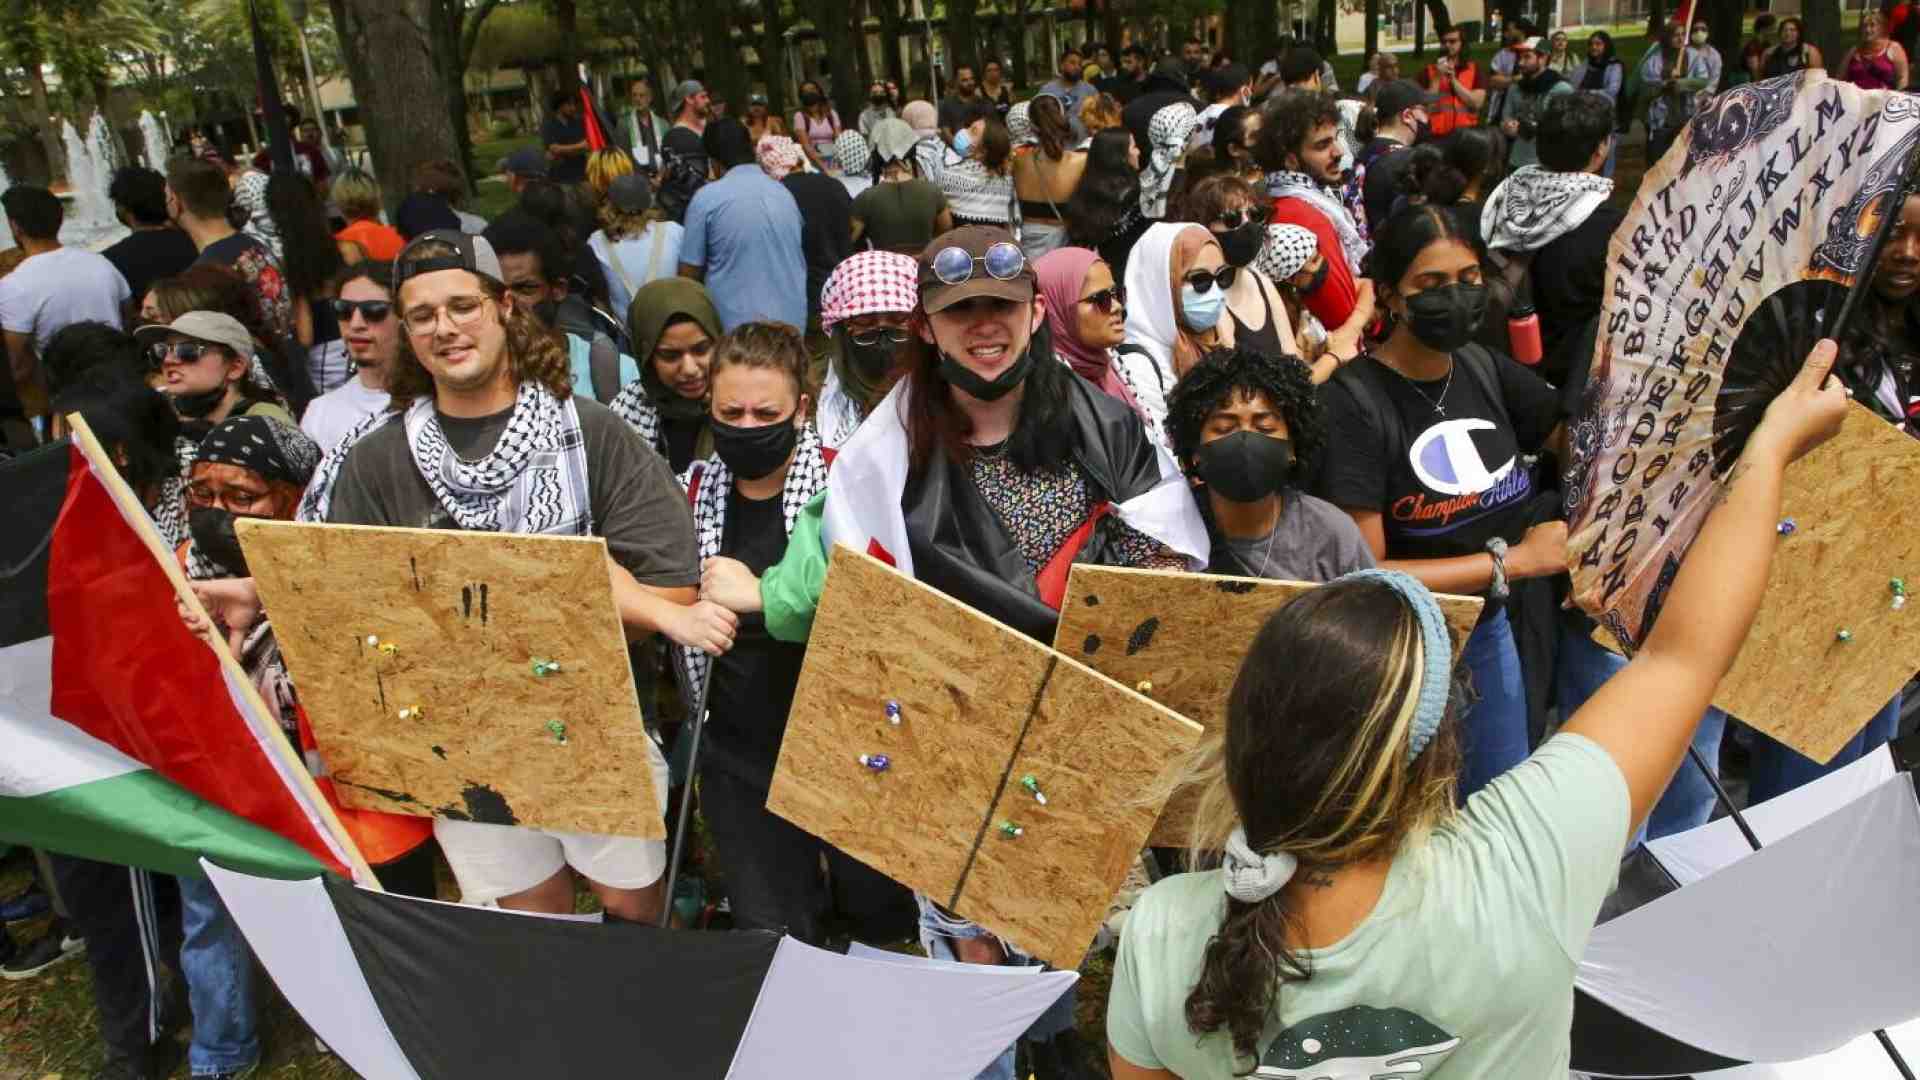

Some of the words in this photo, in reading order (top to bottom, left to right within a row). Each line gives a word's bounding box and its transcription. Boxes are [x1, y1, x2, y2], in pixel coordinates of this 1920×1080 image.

[1608, 178, 1678, 334] SPIRIT
[1624, 204, 1697, 356] BOARD
[1391, 491, 1481, 525] Champion
